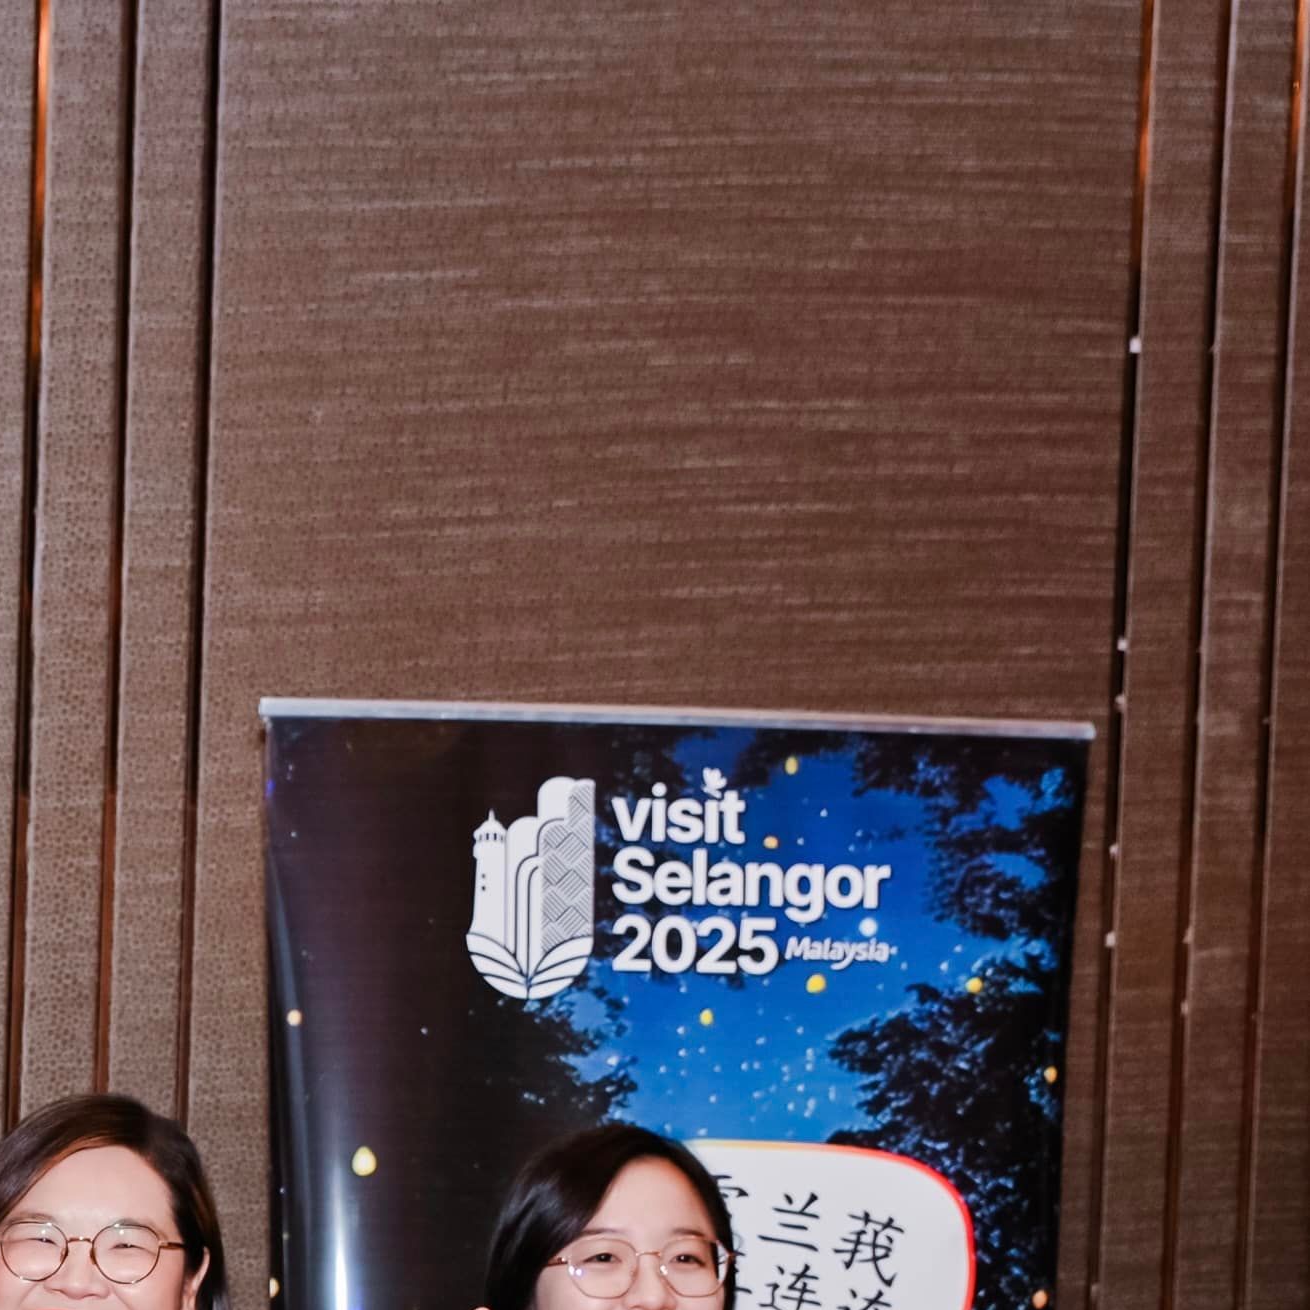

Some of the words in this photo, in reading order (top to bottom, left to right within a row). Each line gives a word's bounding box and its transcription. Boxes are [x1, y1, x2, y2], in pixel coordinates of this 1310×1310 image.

[611, 781, 745, 844] visit
[611, 846, 891, 922] Selangor
[611, 915, 779, 976] 2025
[784, 935, 891, 970] Malaysia
